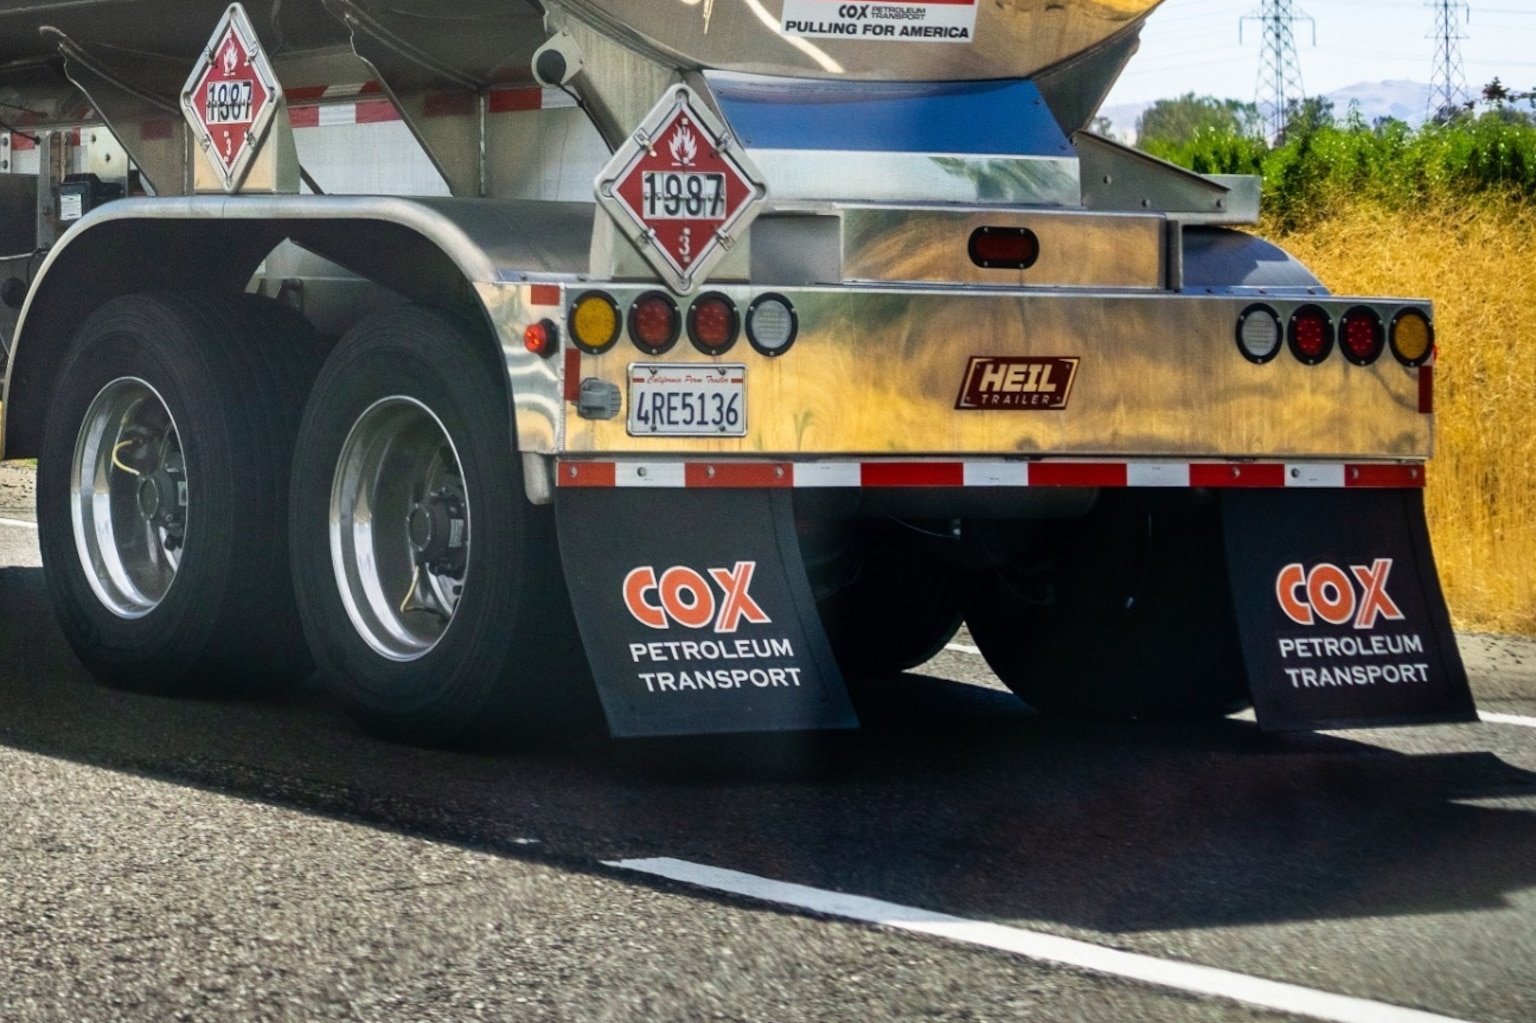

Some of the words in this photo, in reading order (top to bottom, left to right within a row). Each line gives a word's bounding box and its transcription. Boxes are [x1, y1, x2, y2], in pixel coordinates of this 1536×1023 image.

[838, 4, 870, 20] COX
[870, 12, 926, 21] TRANSPORT
[871, 5, 926, 15] PETROLEUM
[785, 20, 857, 35] PULLING
[862, 24, 896, 36] FOR
[899, 25, 969, 39] AMERICA
[208, 82, 252, 121] 1987
[225, 138, 232, 155] 3
[644, 172, 724, 216] 1987
[678, 232, 691, 258] 3
[979, 363, 1057, 392] HEIL
[637, 391, 739, 425] 4RE5136
[981, 394, 1051, 405] TRAILER
[622, 561, 772, 633] COX
[1276, 558, 1406, 629] COX
[629, 638, 795, 662] PETROLEUM
[1278, 634, 1424, 658] PETROLEUM
[638, 667, 801, 692] TRANSPORT
[1285, 664, 1429, 688] TRANSPORT
